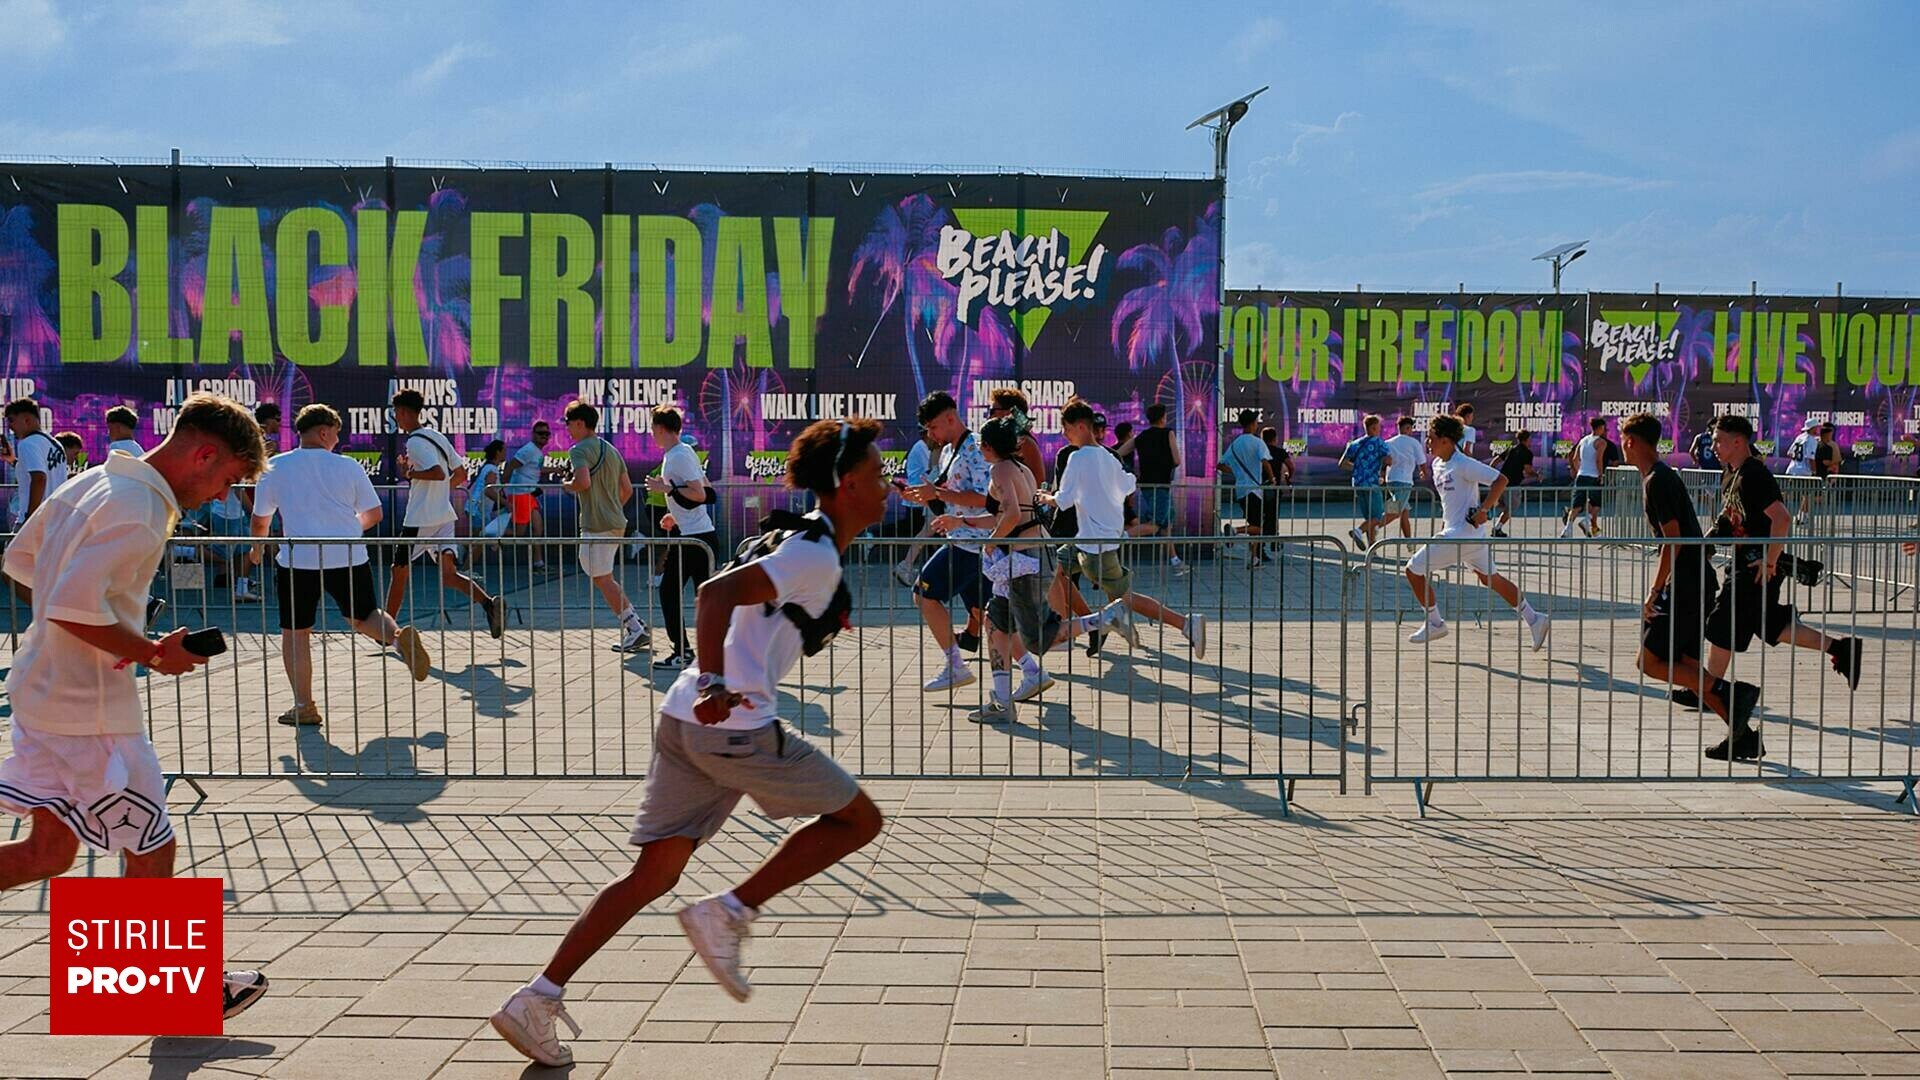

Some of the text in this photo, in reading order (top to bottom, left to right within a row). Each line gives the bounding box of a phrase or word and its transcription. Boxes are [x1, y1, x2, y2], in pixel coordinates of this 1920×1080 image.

[57, 203, 836, 369] BLACK FRIDAY
[956, 244, 1105, 324] PLEASE!
[1343, 308, 1563, 383] FREEDOM
[1600, 329, 1680, 372] PLEASE!
[1712, 311, 1809, 383] LIVE
[579, 378, 677, 406] MY SILENCE
[761, 393, 808, 420] WALK
[810, 393, 845, 419] LIKE
[856, 393, 897, 420] TALK
[1316, 409, 1339, 424] BEEN
[1414, 402, 1440, 417] MAKE
[1505, 402, 1562, 417] CLEAN SLATE
[1601, 401, 1640, 417] RESPECT
[1712, 403, 1760, 417] THE VISION
[1831, 411, 1864, 426] CHOSEN
[348, 408, 381, 434] TEN
[442, 408, 498, 434] AHEAD
[1505, 418, 1562, 432] FULL HUNGER
